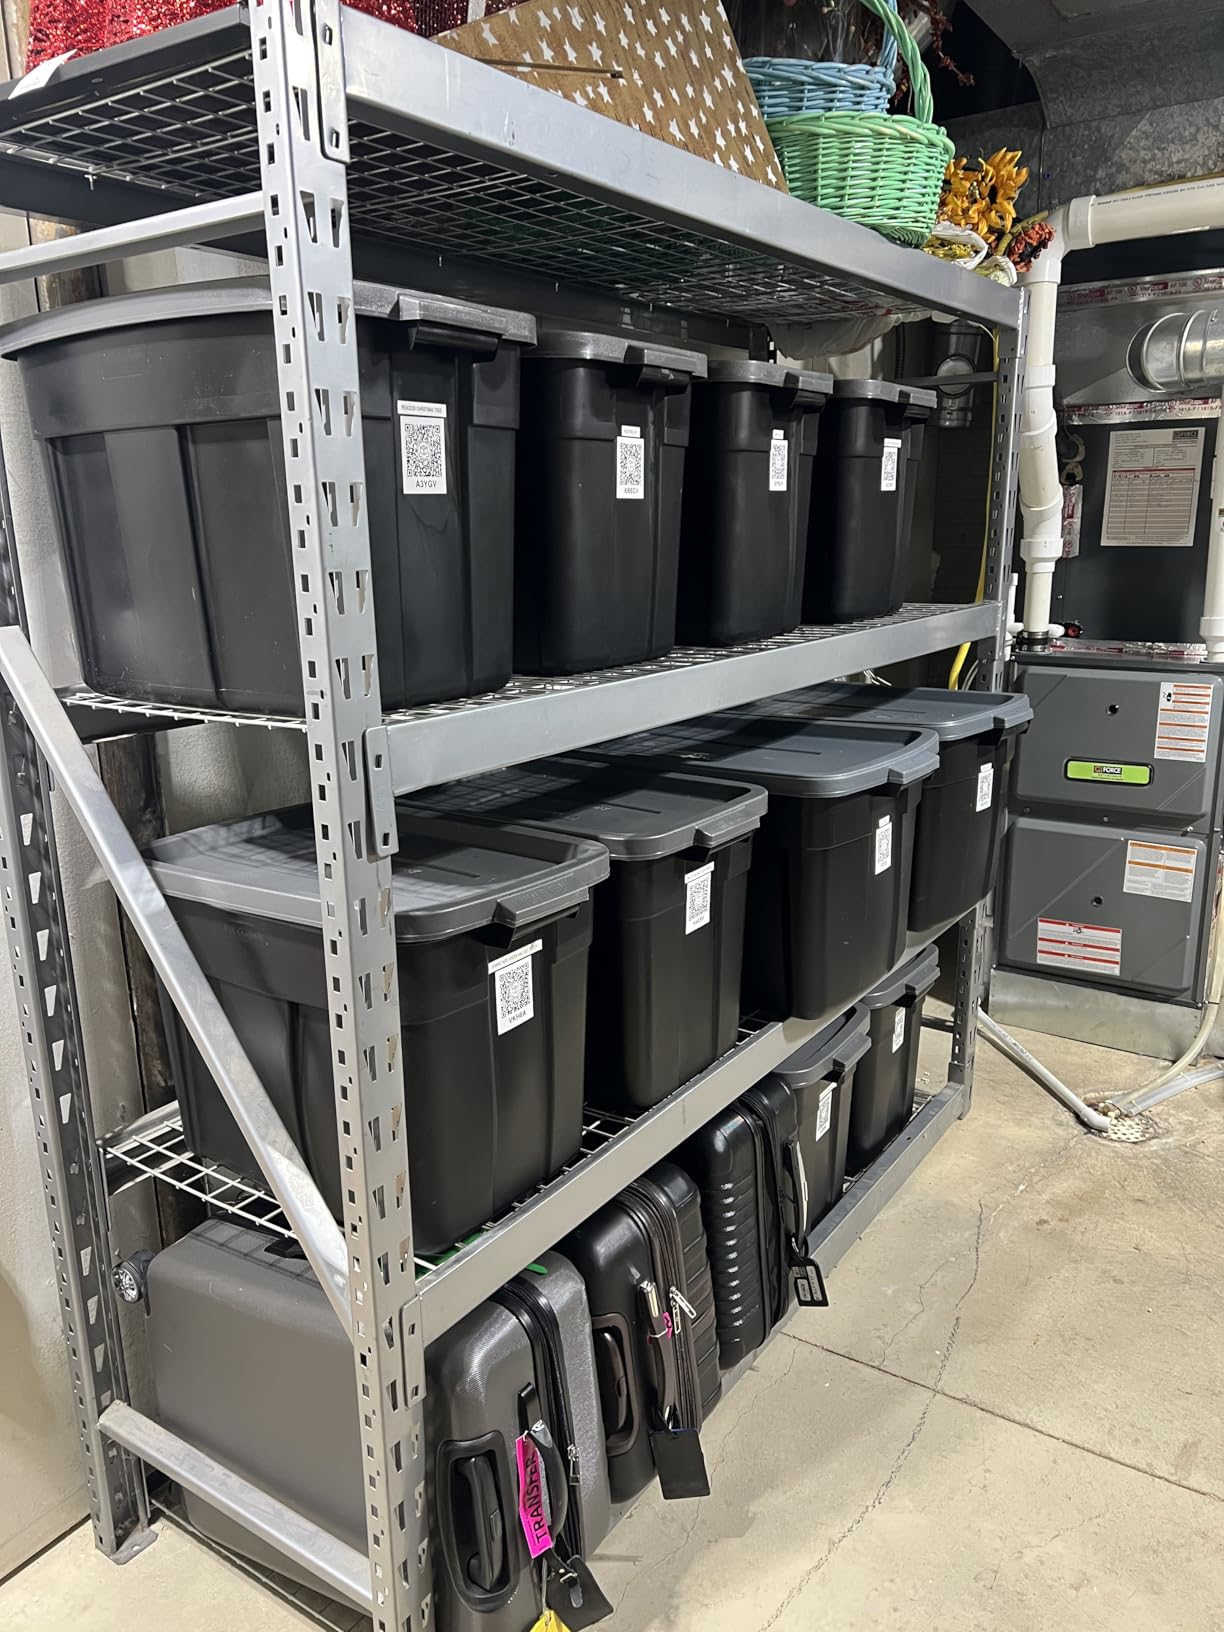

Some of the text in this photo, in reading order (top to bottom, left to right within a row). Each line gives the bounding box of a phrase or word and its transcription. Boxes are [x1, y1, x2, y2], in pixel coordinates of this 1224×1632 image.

[415, 479, 437, 488] A3YGV
[1102, 766, 1122, 774] FORCE
[526, 1450, 548, 1544] TRANSFER
